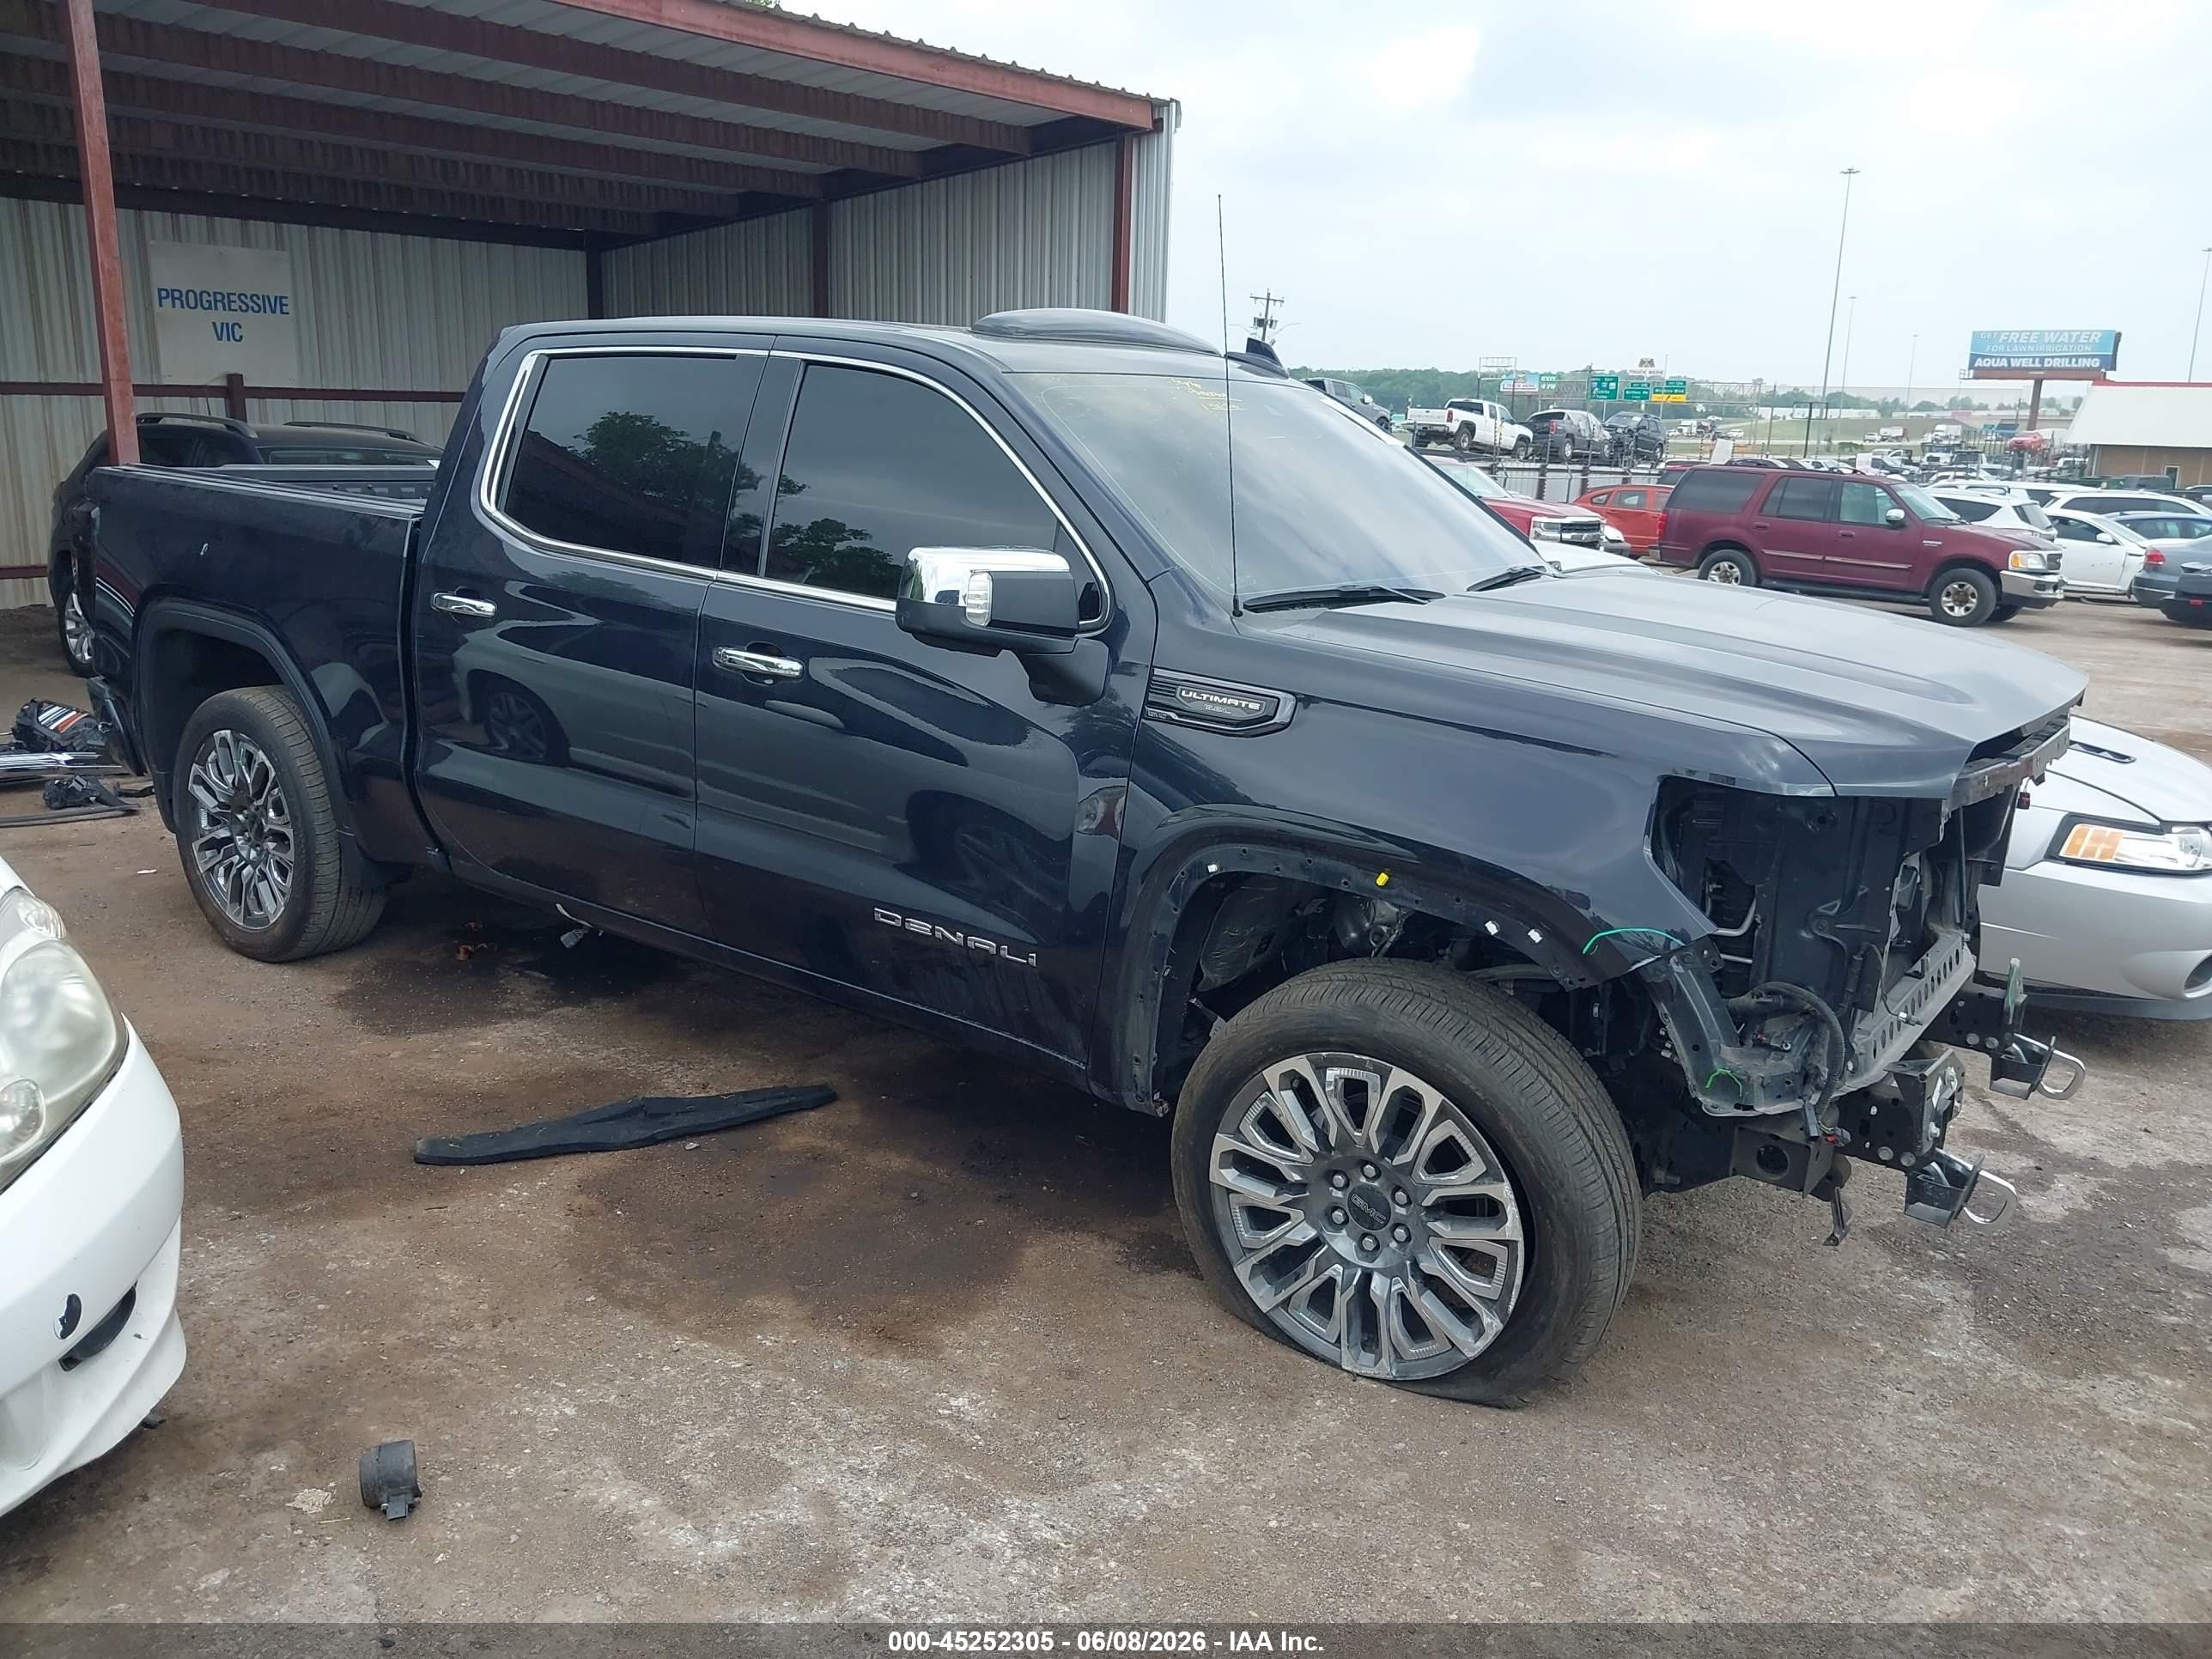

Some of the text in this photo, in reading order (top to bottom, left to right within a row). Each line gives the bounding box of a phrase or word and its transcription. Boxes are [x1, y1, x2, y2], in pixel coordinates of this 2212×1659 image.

[157, 288, 289, 315] PROGRESSIVE
[212, 322, 243, 343] VIC
[1998, 331, 2040, 343] FREE
[2044, 331, 2102, 343] WATER
[1974, 357, 2100, 368] AQUA WELL DRILLING
[1181, 690, 1261, 710] ULTIMATE
[874, 907, 1036, 968] DENALI
[1351, 1194, 1388, 1224] GMC
